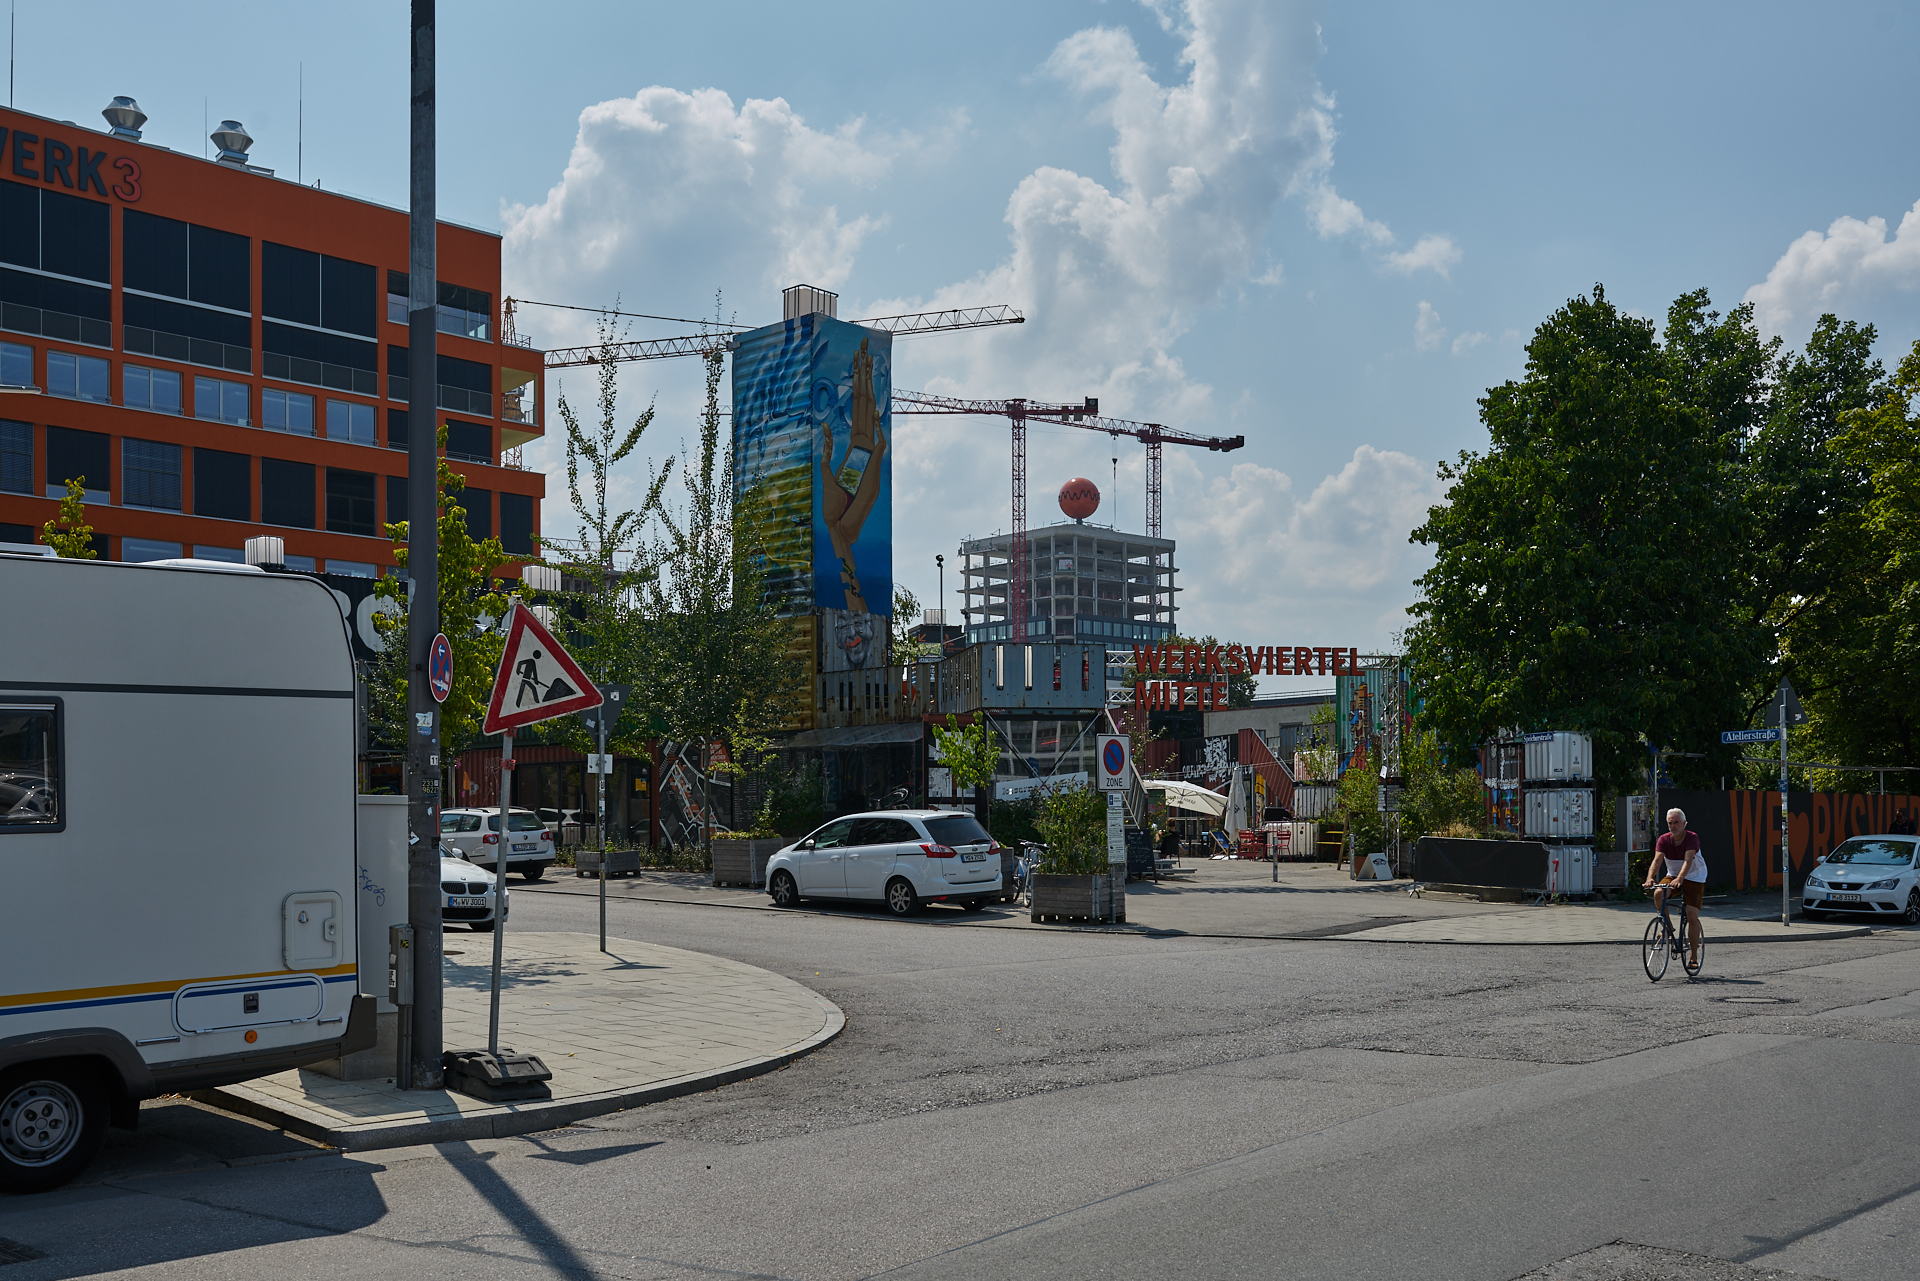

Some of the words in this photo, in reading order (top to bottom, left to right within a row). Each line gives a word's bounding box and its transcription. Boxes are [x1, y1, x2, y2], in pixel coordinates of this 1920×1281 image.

[0, 127, 109, 197] ERK
[113, 157, 142, 202] 3
[1133, 644, 1366, 676] WERKSVIERTEL
[1135, 682, 1228, 711] MITTE
[1523, 733, 1553, 743] Speicherstraße
[1726, 730, 1776, 741] Atelierstraße
[1106, 778, 1123, 787] ZONE
